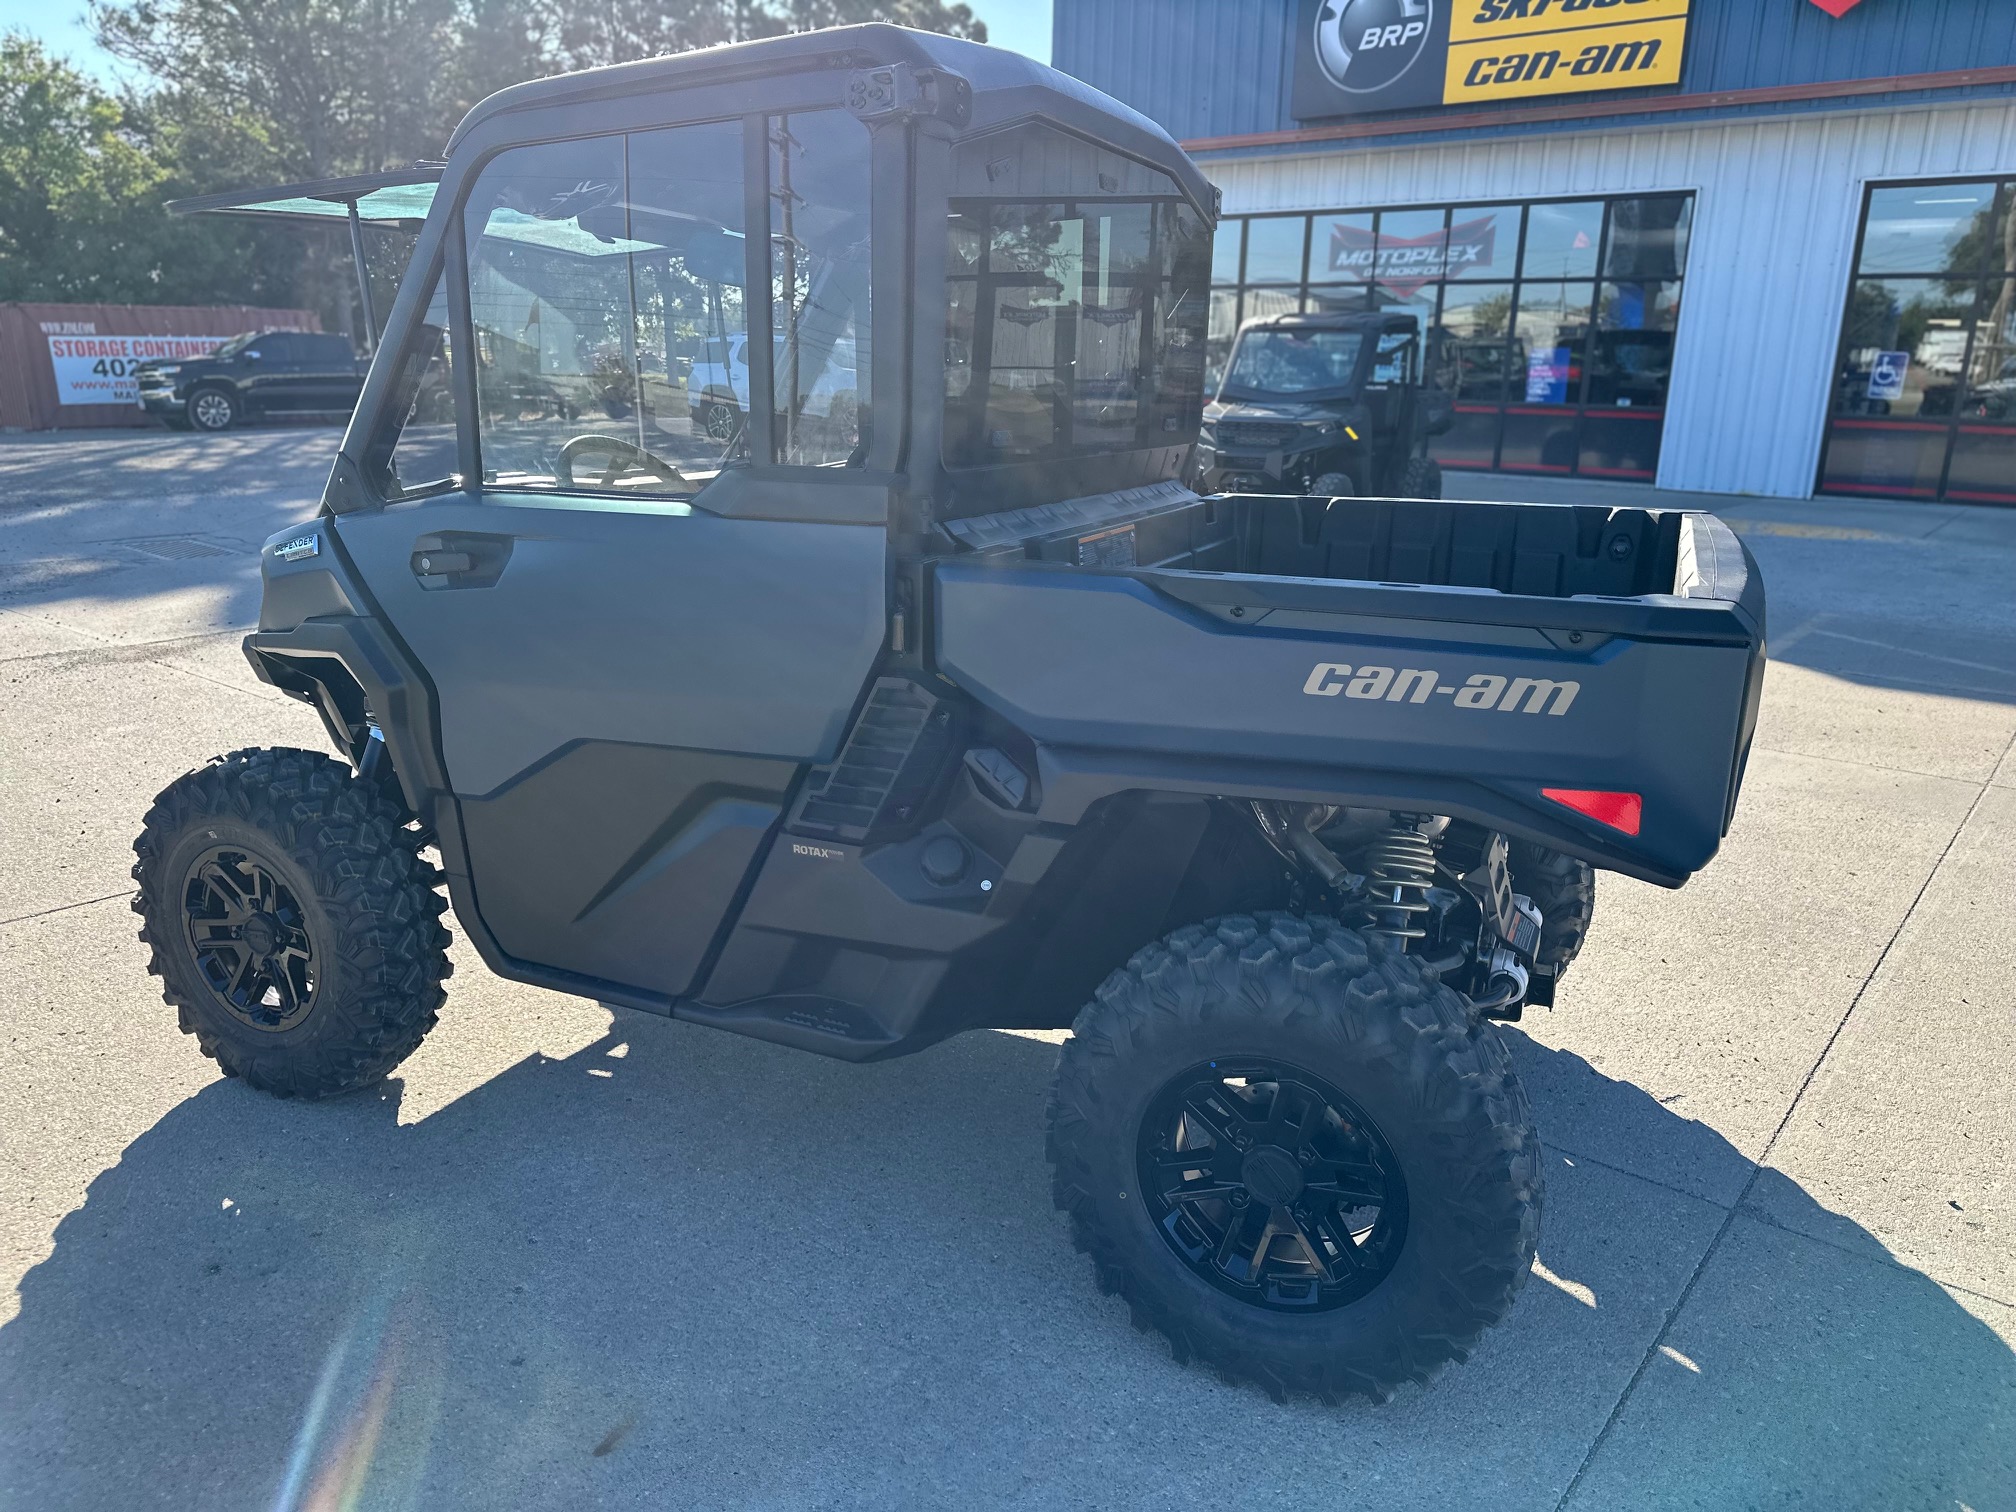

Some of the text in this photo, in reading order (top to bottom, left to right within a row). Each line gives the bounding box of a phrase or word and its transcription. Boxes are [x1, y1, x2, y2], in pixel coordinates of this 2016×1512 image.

[1358, 22, 1424, 51] BRP
[1463, 38, 1662, 87] can-am
[1336, 244, 1483, 266] MOTOPLEX
[53, 340, 130, 357] STORAGE
[71, 380, 137, 390] www.ma
[275, 536, 315, 553] DEFENDER
[1303, 662, 1580, 716] can-am
[793, 844, 829, 859] ROTAX
